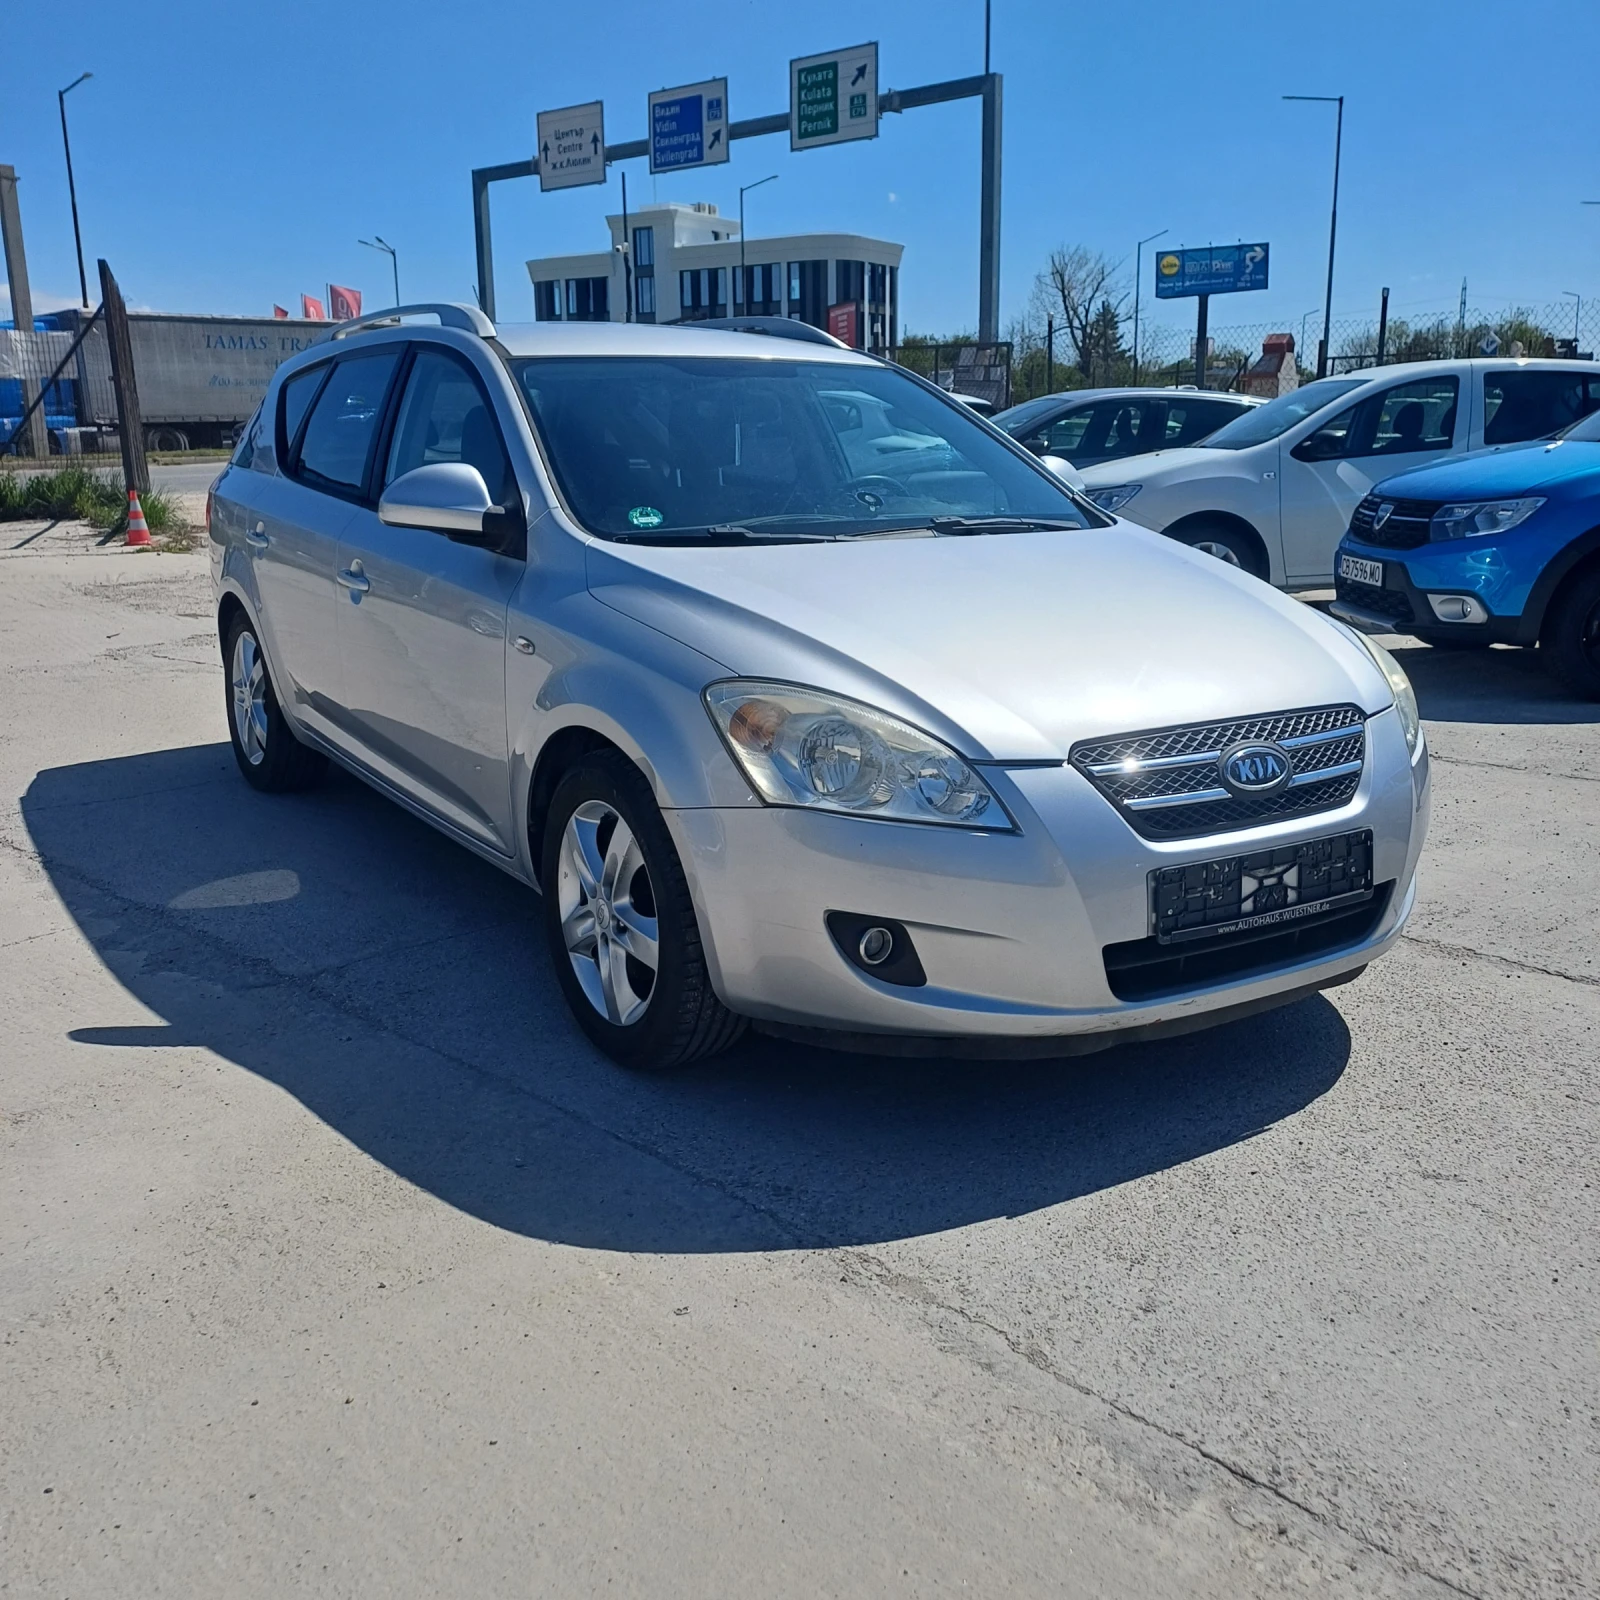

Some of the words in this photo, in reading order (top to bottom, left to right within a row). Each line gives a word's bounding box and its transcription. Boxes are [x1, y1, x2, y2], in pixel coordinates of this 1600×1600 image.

[801, 69, 834, 86] Кулата
[801, 86, 832, 101] Kulata
[654, 104, 681, 118] Видин
[800, 101, 835, 116] Перник
[655, 120, 678, 133] Vidin
[801, 117, 832, 133] Pernik
[554, 127, 585, 141] Център
[655, 132, 701, 148] Свиленград
[557, 142, 583, 155] Centre
[655, 145, 698, 164] Svilengrad
[1236, 755, 1281, 782] KIA
[1217, 902, 1330, 935] www.AUTOHAUS-WUESTNER.de
